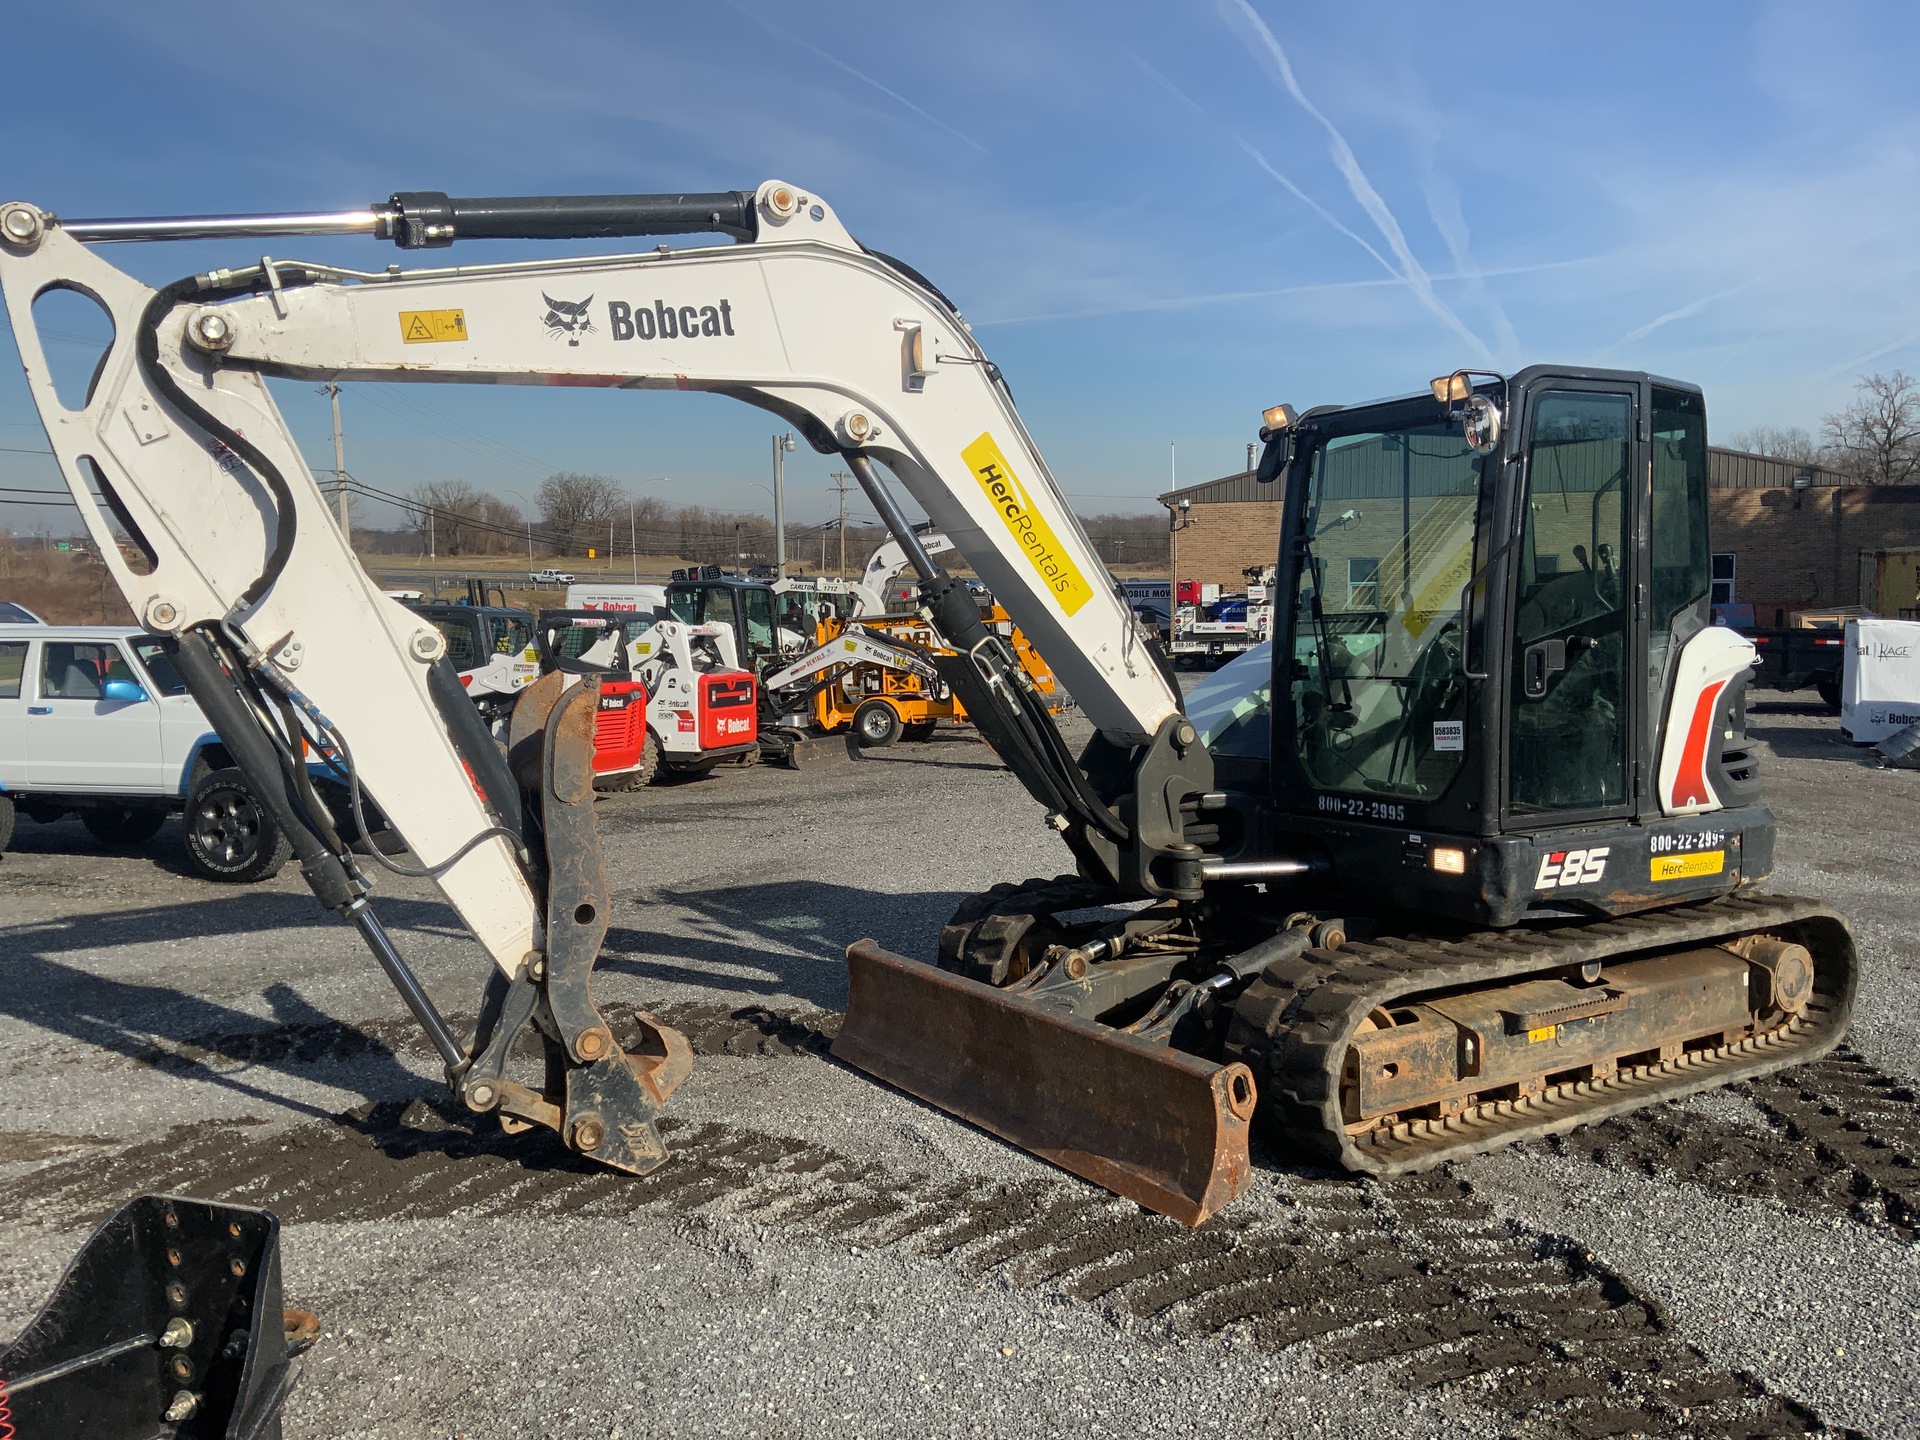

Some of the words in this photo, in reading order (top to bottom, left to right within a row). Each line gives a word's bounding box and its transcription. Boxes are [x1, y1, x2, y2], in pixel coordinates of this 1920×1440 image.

[607, 298, 736, 341] Bobcat
[979, 463, 1070, 592] HercRentals
[1128, 590, 1150, 598] OBILE
[602, 601, 637, 612] Bobcat
[872, 649, 893, 663] Bobcat
[609, 698, 623, 708] Bobcat
[728, 718, 750, 734] Bobcat
[1318, 794, 1405, 821] 800-22-2995
[1534, 847, 1610, 891] E85
[1661, 859, 1715, 876] HercRentals
